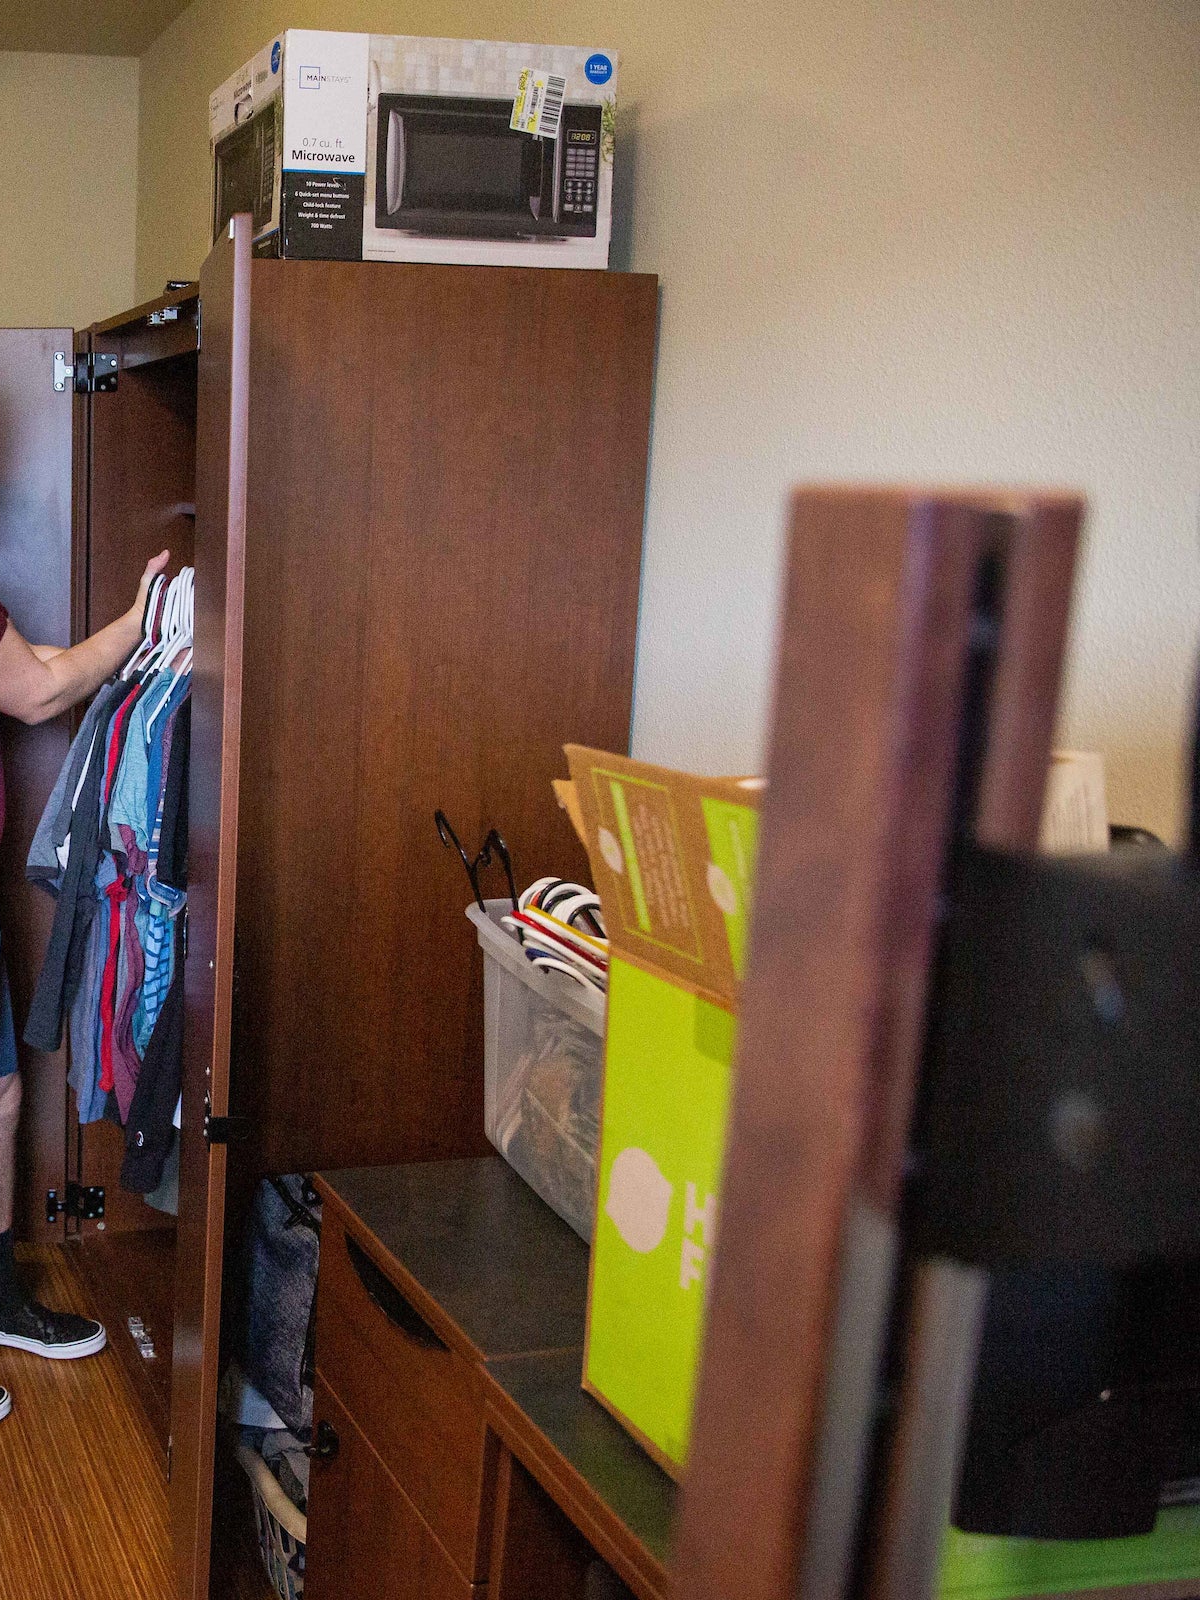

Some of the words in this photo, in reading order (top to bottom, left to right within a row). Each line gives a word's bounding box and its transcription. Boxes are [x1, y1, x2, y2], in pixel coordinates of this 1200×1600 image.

[302, 137, 317, 148] 0.7
[319, 140, 333, 148] cu.
[291, 149, 356, 163] Microwave
